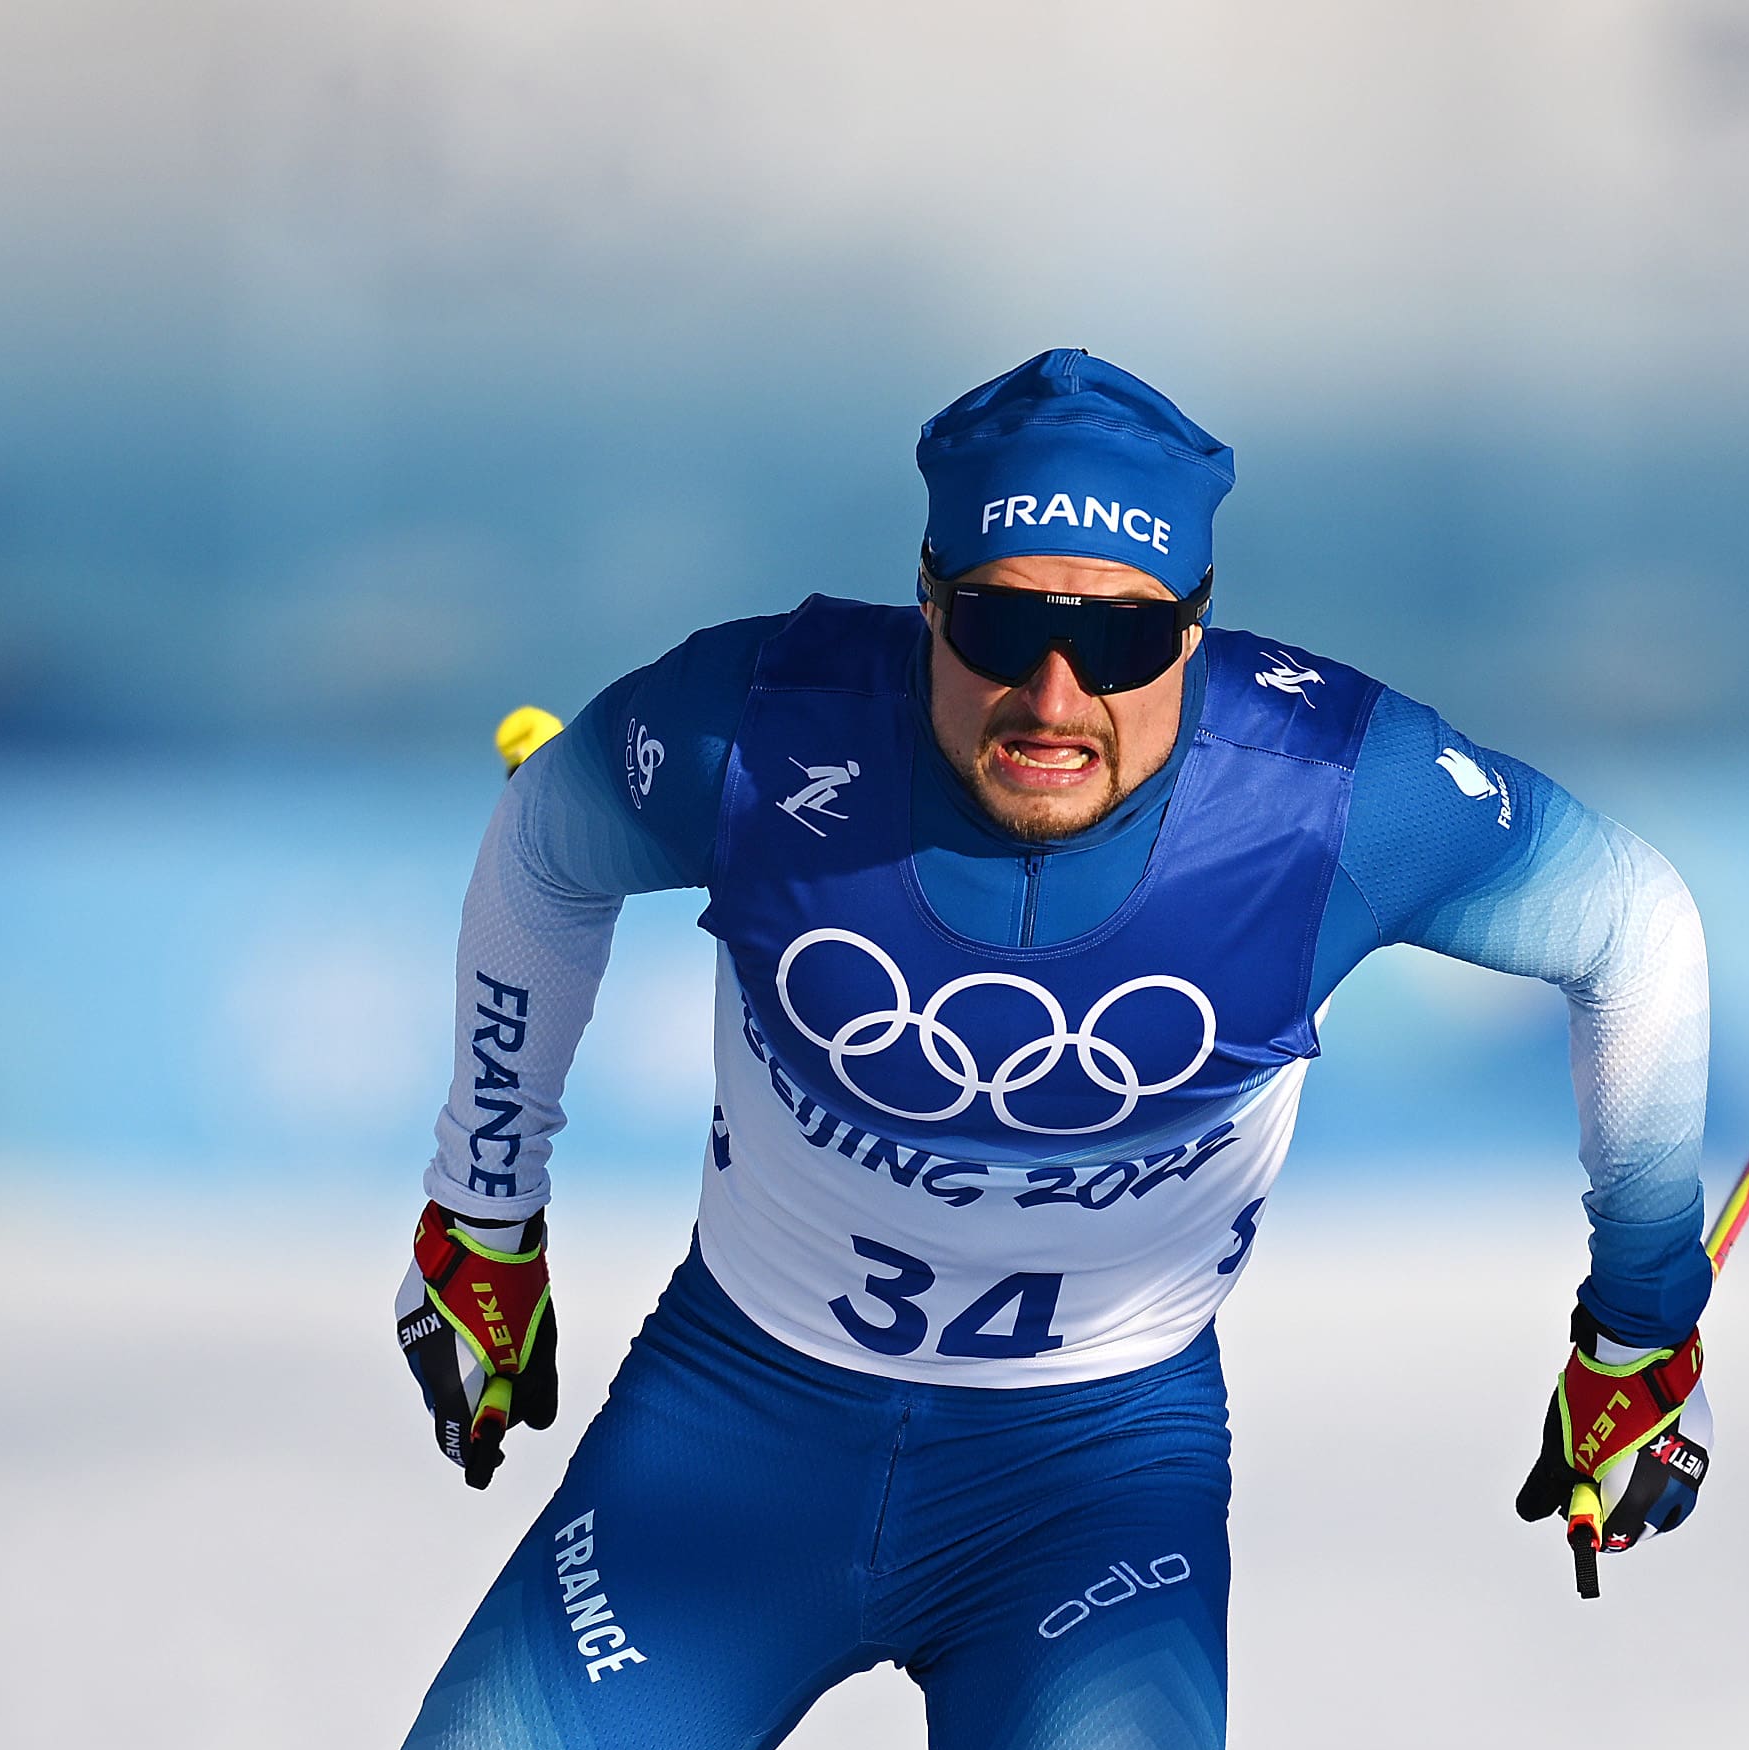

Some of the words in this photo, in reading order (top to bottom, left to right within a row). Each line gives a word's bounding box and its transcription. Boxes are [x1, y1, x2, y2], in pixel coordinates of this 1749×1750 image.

[981, 493, 1171, 555] FRANCE
[469, 969, 529, 1198] FRANCE
[739, 991, 988, 1209] BEIJING
[1013, 1121, 1241, 1211] 2022
[471, 1282, 518, 1366] LEKI
[828, 1234, 1065, 1359] 34
[1575, 1390, 1631, 1470] LEKI
[554, 1508, 648, 1683] FRANCE
[1038, 1552, 1190, 1639] odlo
